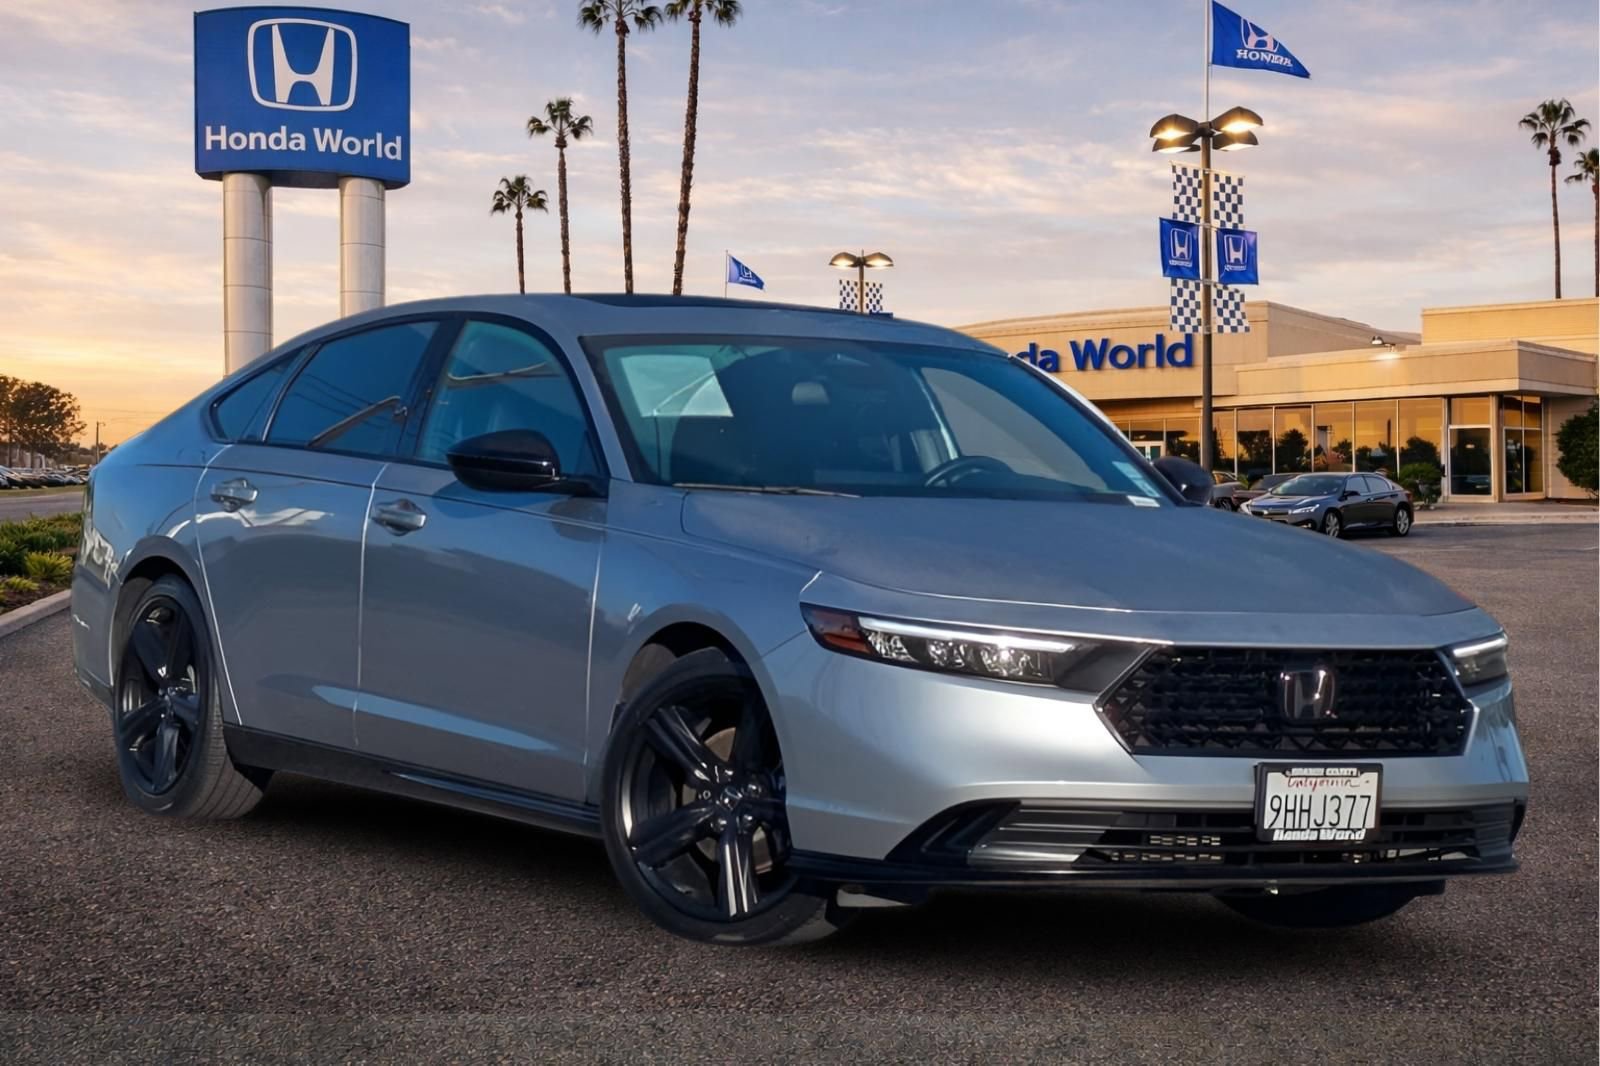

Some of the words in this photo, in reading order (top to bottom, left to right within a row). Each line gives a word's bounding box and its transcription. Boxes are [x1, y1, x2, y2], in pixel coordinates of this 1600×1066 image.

[205, 126, 306, 151] Honda
[312, 128, 402, 160] World
[1069, 333, 1193, 371] World
[1269, 794, 1372, 829] 9HHJ377
